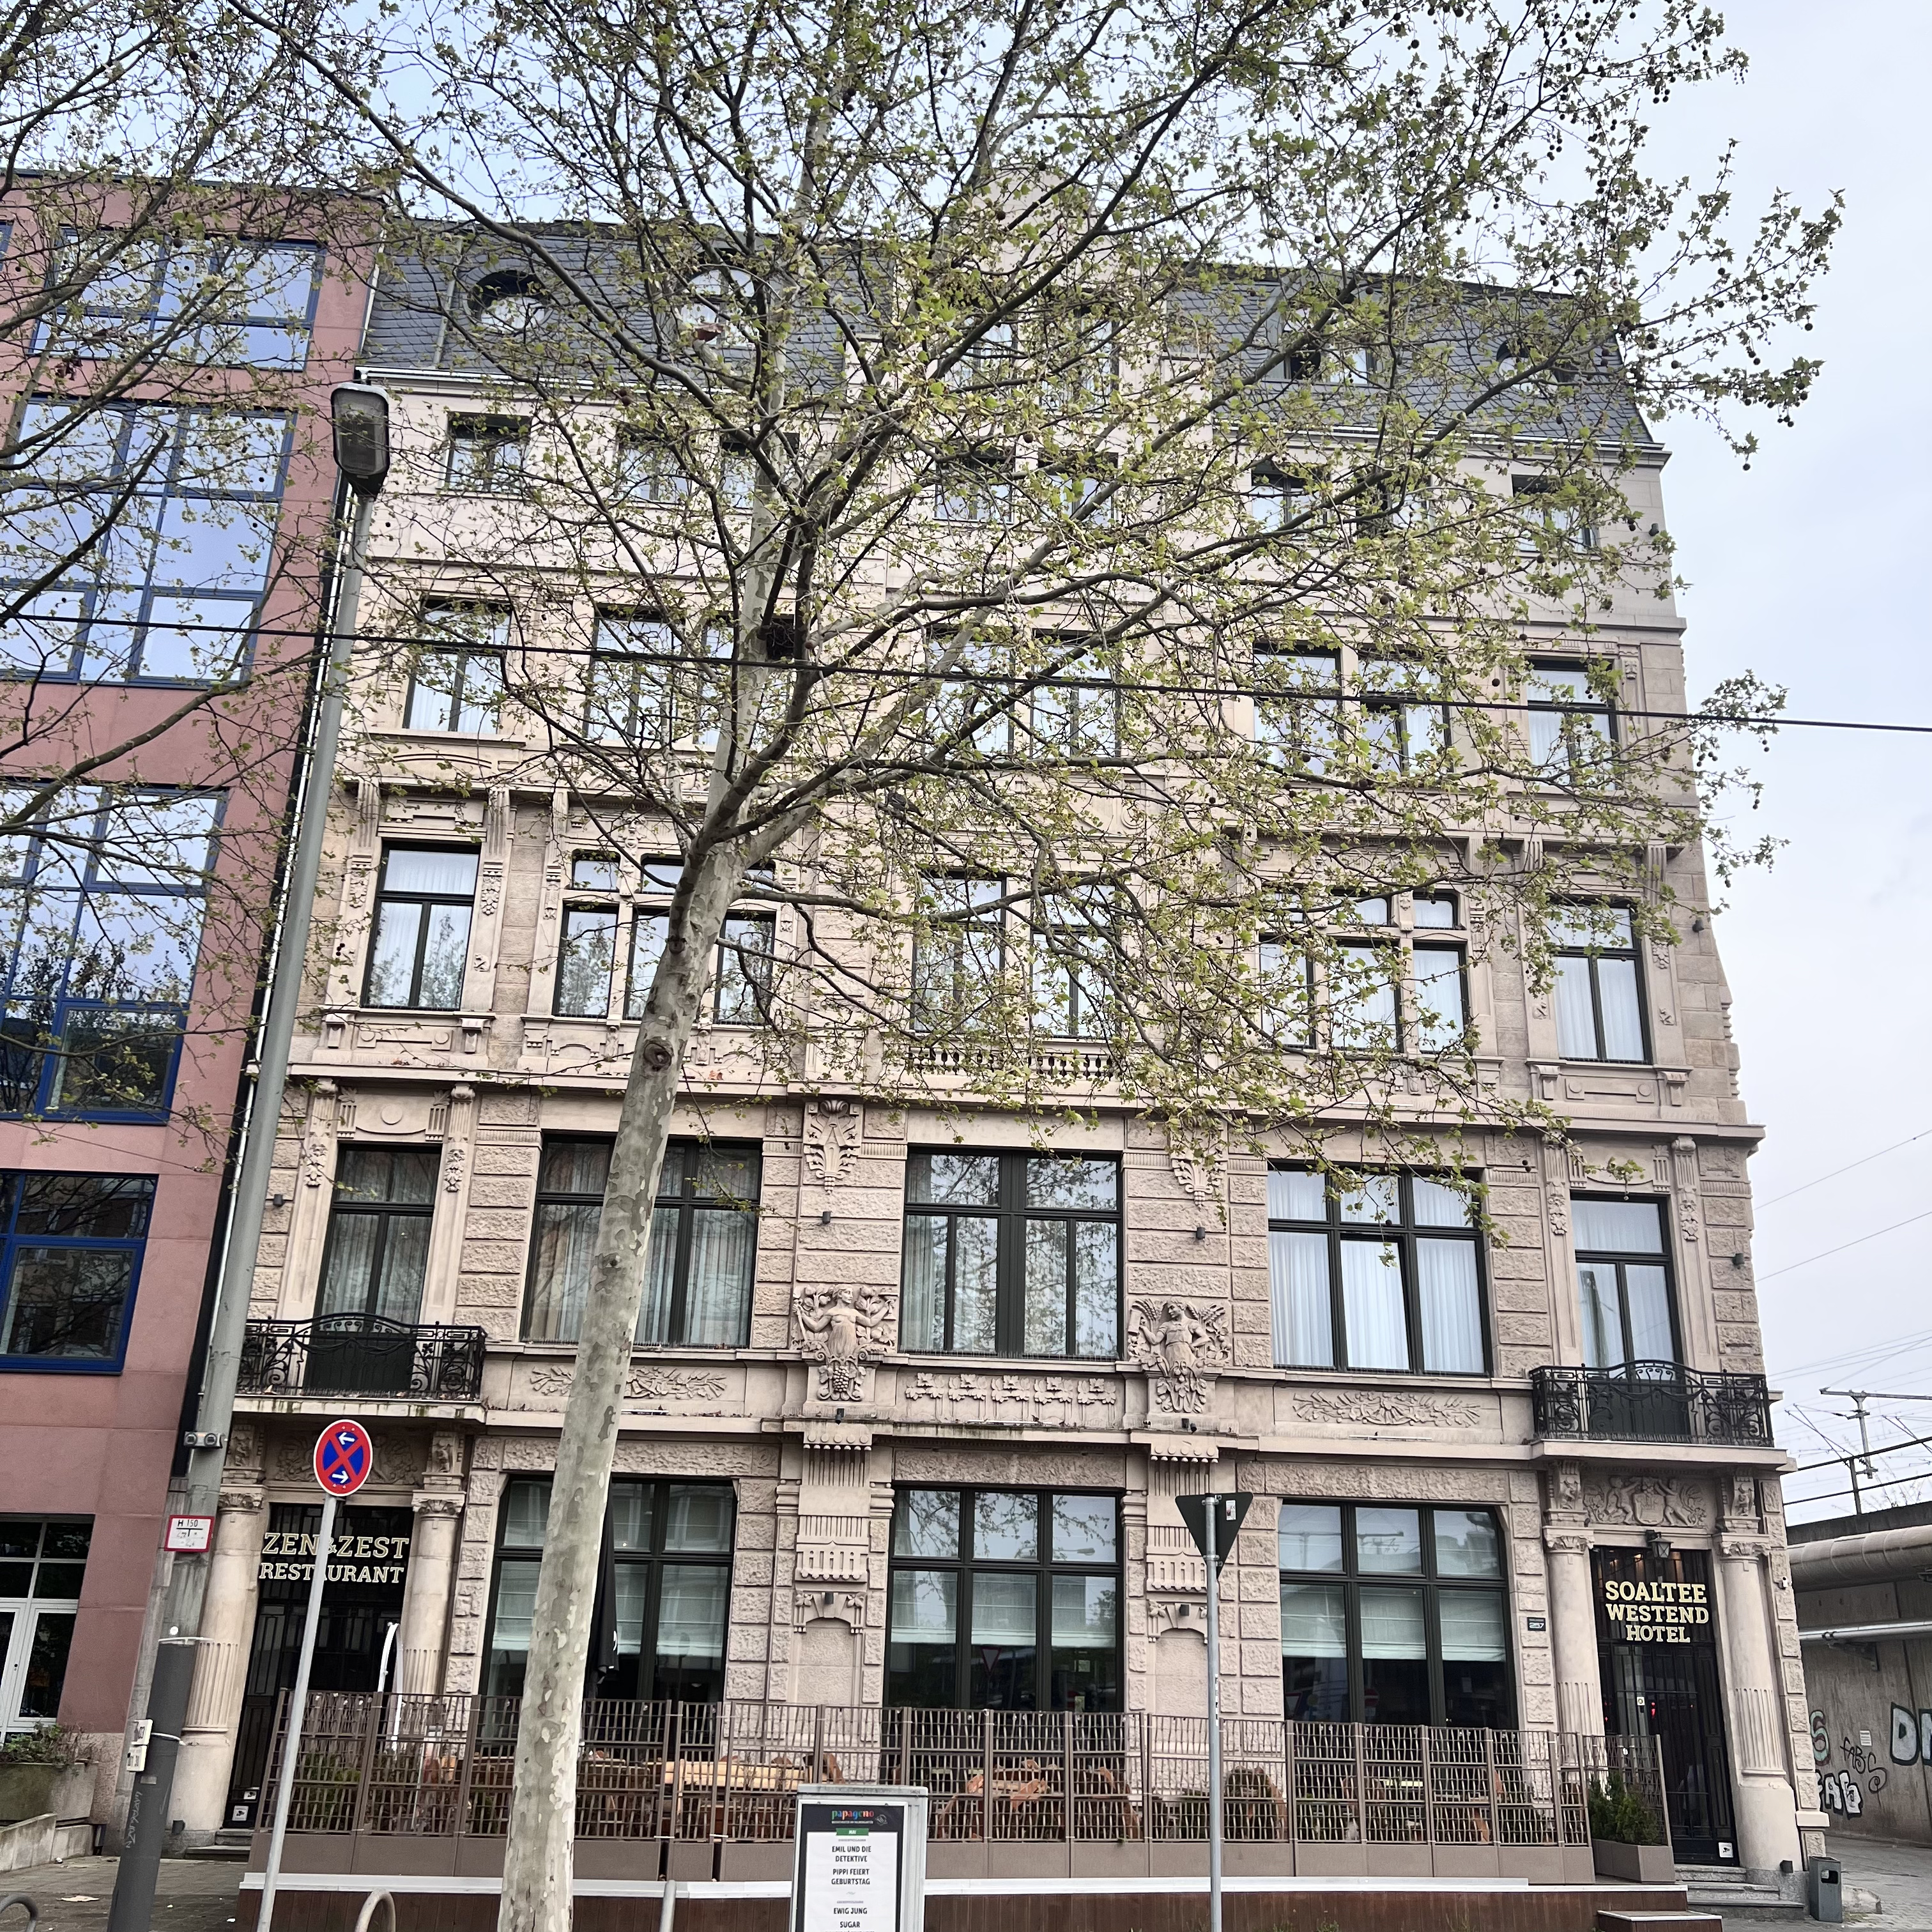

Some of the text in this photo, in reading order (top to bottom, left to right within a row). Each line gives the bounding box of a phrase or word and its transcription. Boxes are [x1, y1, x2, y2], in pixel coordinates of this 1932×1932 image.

[259, 1563, 404, 1584] RESTURANT
[1605, 1580, 1707, 1603] SOALTEE
[1606, 1603, 1709, 1624] WESTEND
[1625, 1625, 1690, 1643] HOTEL
[832, 1810, 874, 1820] papageno
